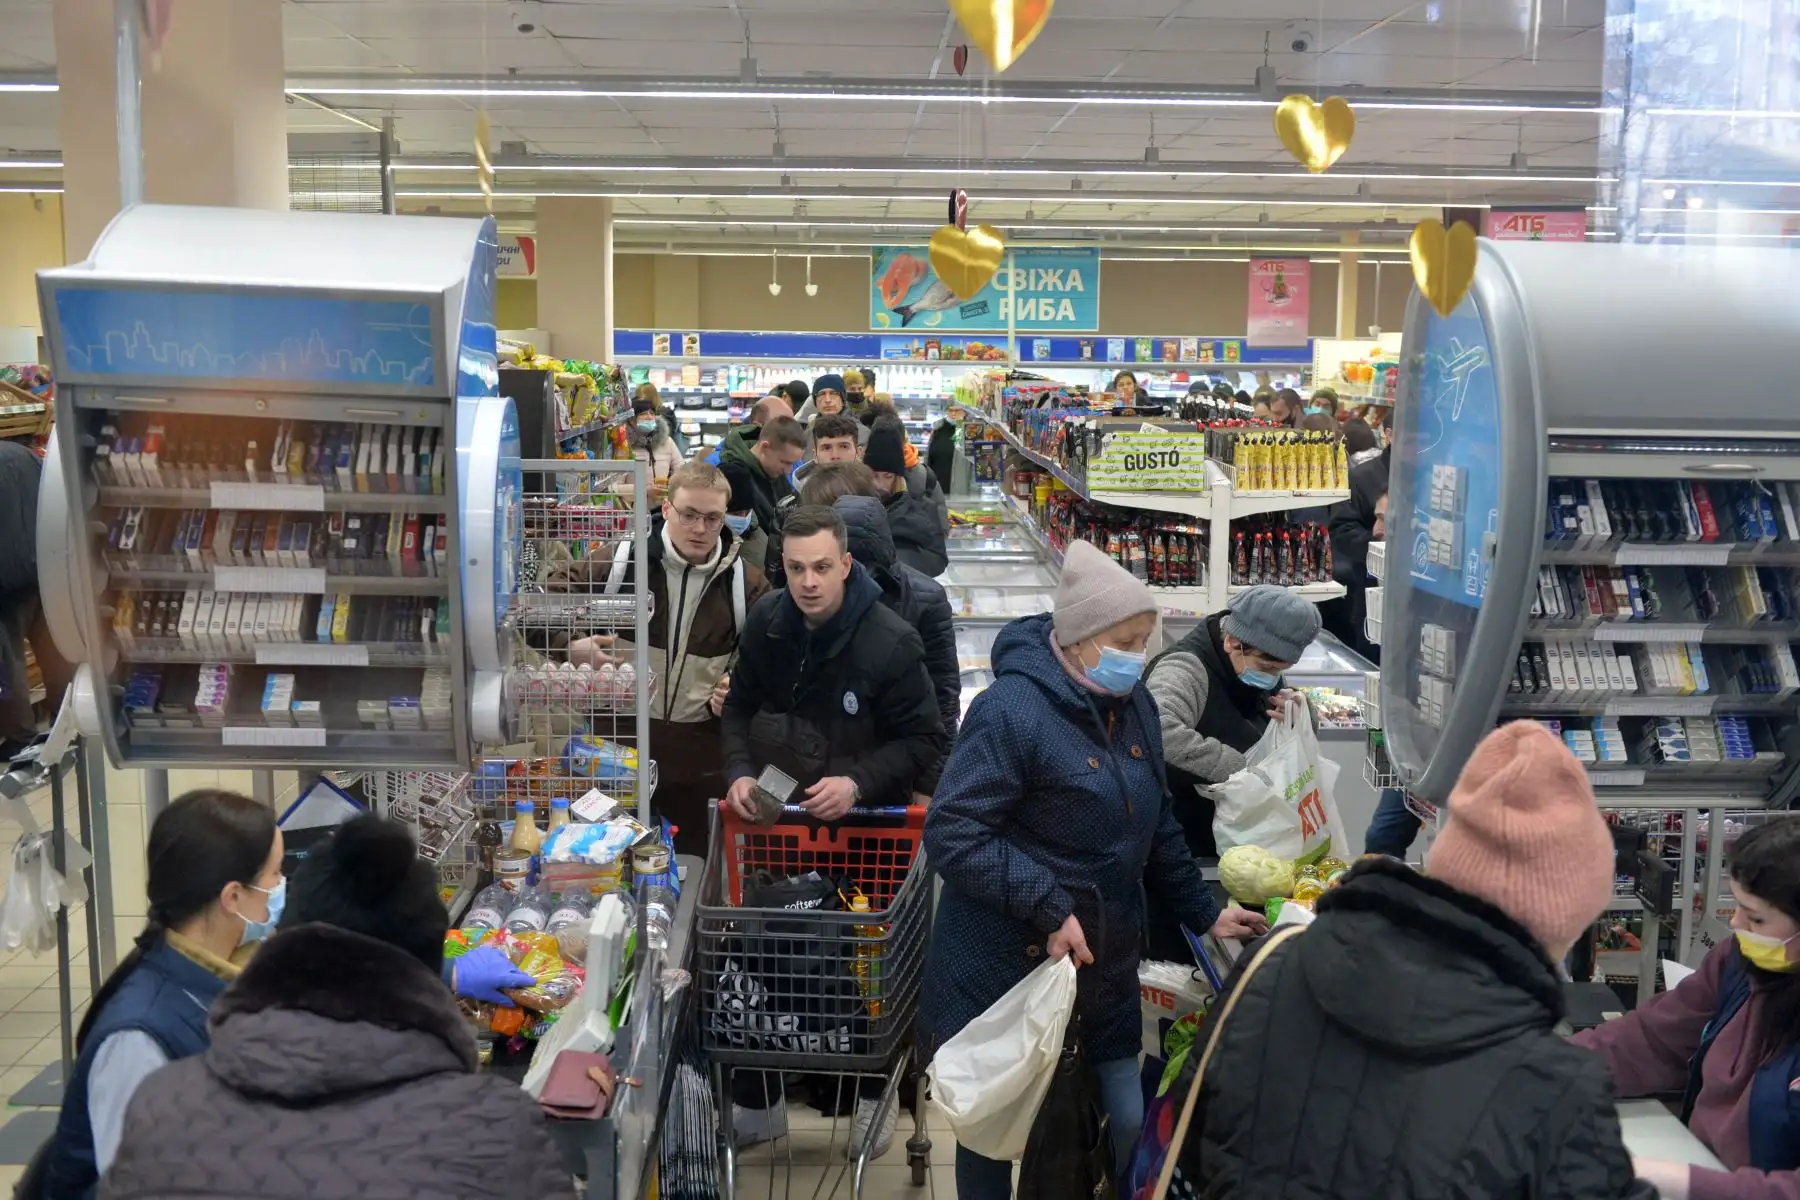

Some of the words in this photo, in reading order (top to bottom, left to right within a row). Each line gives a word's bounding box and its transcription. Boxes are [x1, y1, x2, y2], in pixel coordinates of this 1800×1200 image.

[1503, 214, 1546, 232] АТБ
[991, 268, 1085, 292] СВІЖА
[998, 297, 1077, 321] РИБА
[1124, 446, 1180, 471] GUSTÓ
[784, 898, 823, 911] softserv
